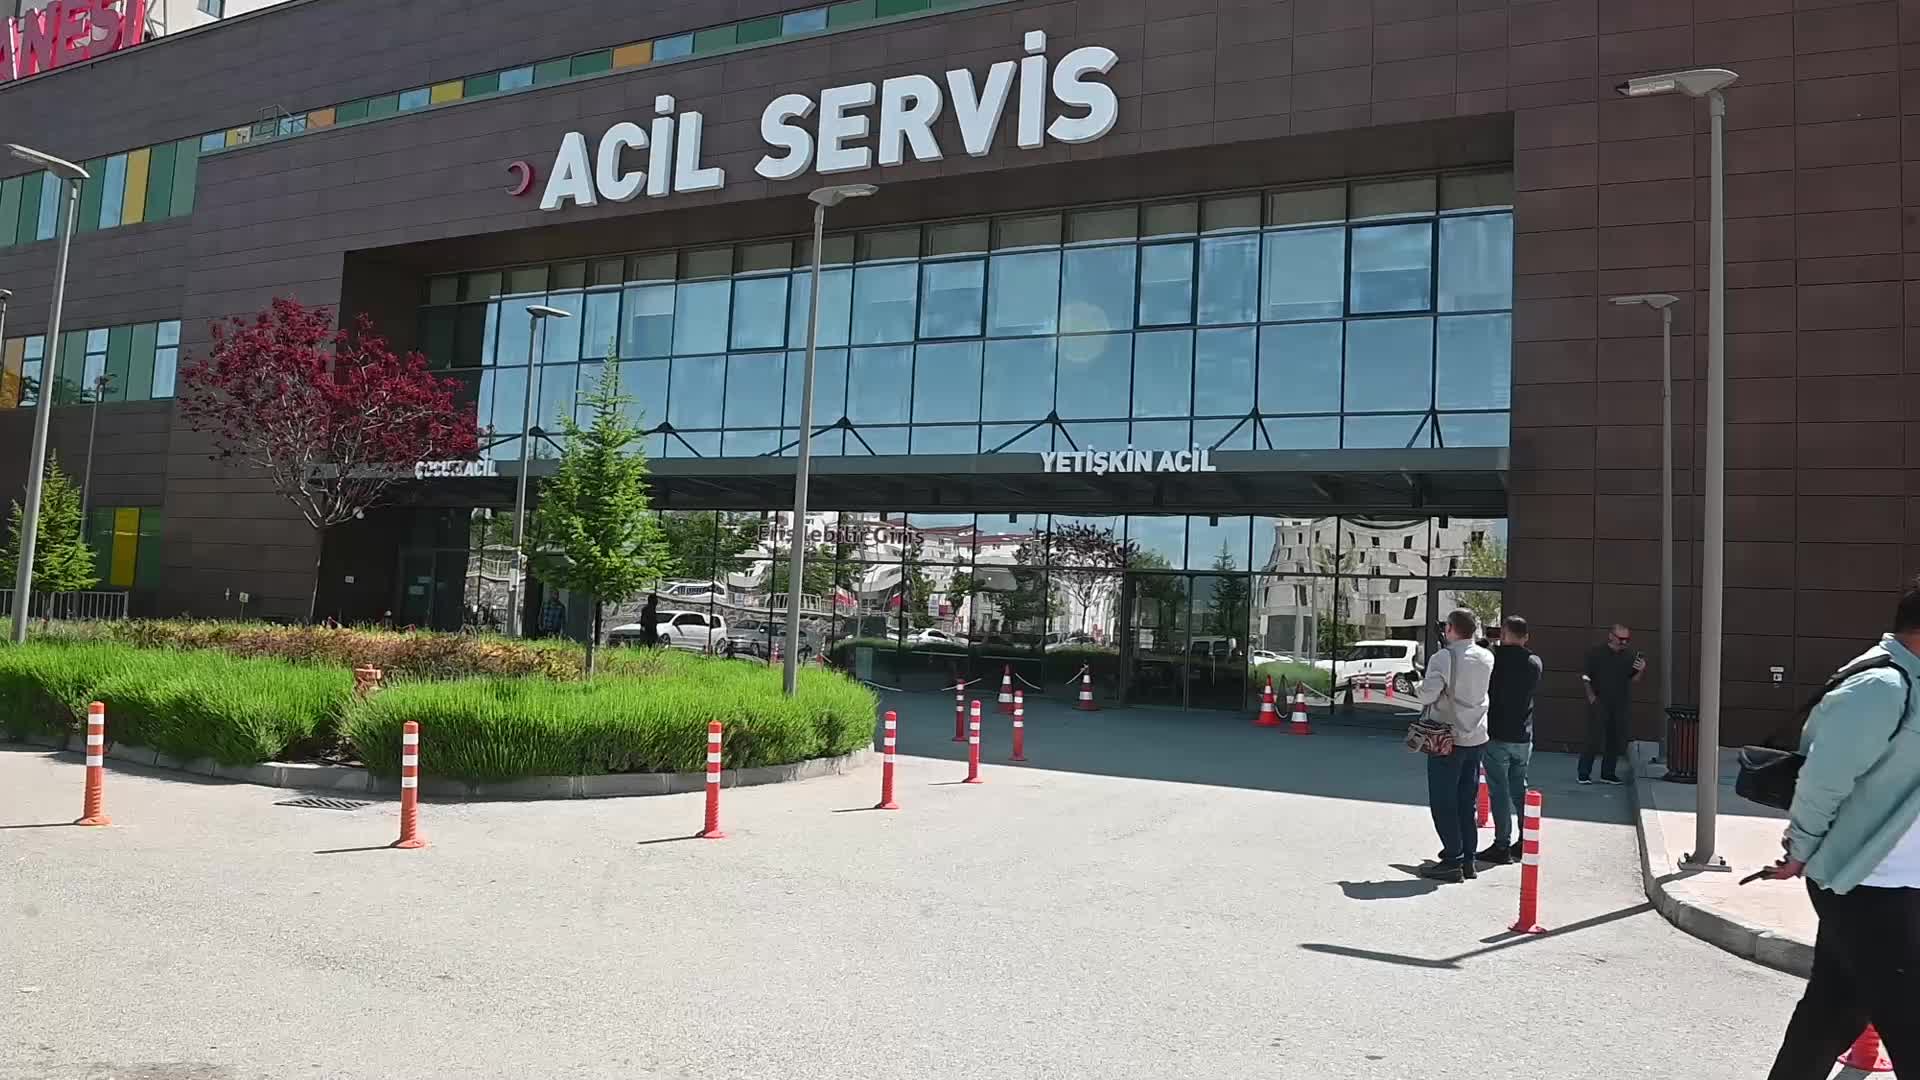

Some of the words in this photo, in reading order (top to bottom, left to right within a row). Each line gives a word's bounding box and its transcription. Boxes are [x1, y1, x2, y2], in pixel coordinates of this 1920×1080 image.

[540, 95, 724, 210] ACİL
[755, 30, 1119, 180] SERVİS
[1040, 444, 1153, 476] YETİŞKİN
[1157, 442, 1217, 472] ACİL
[758, 525, 868, 544] Erişlebilir
